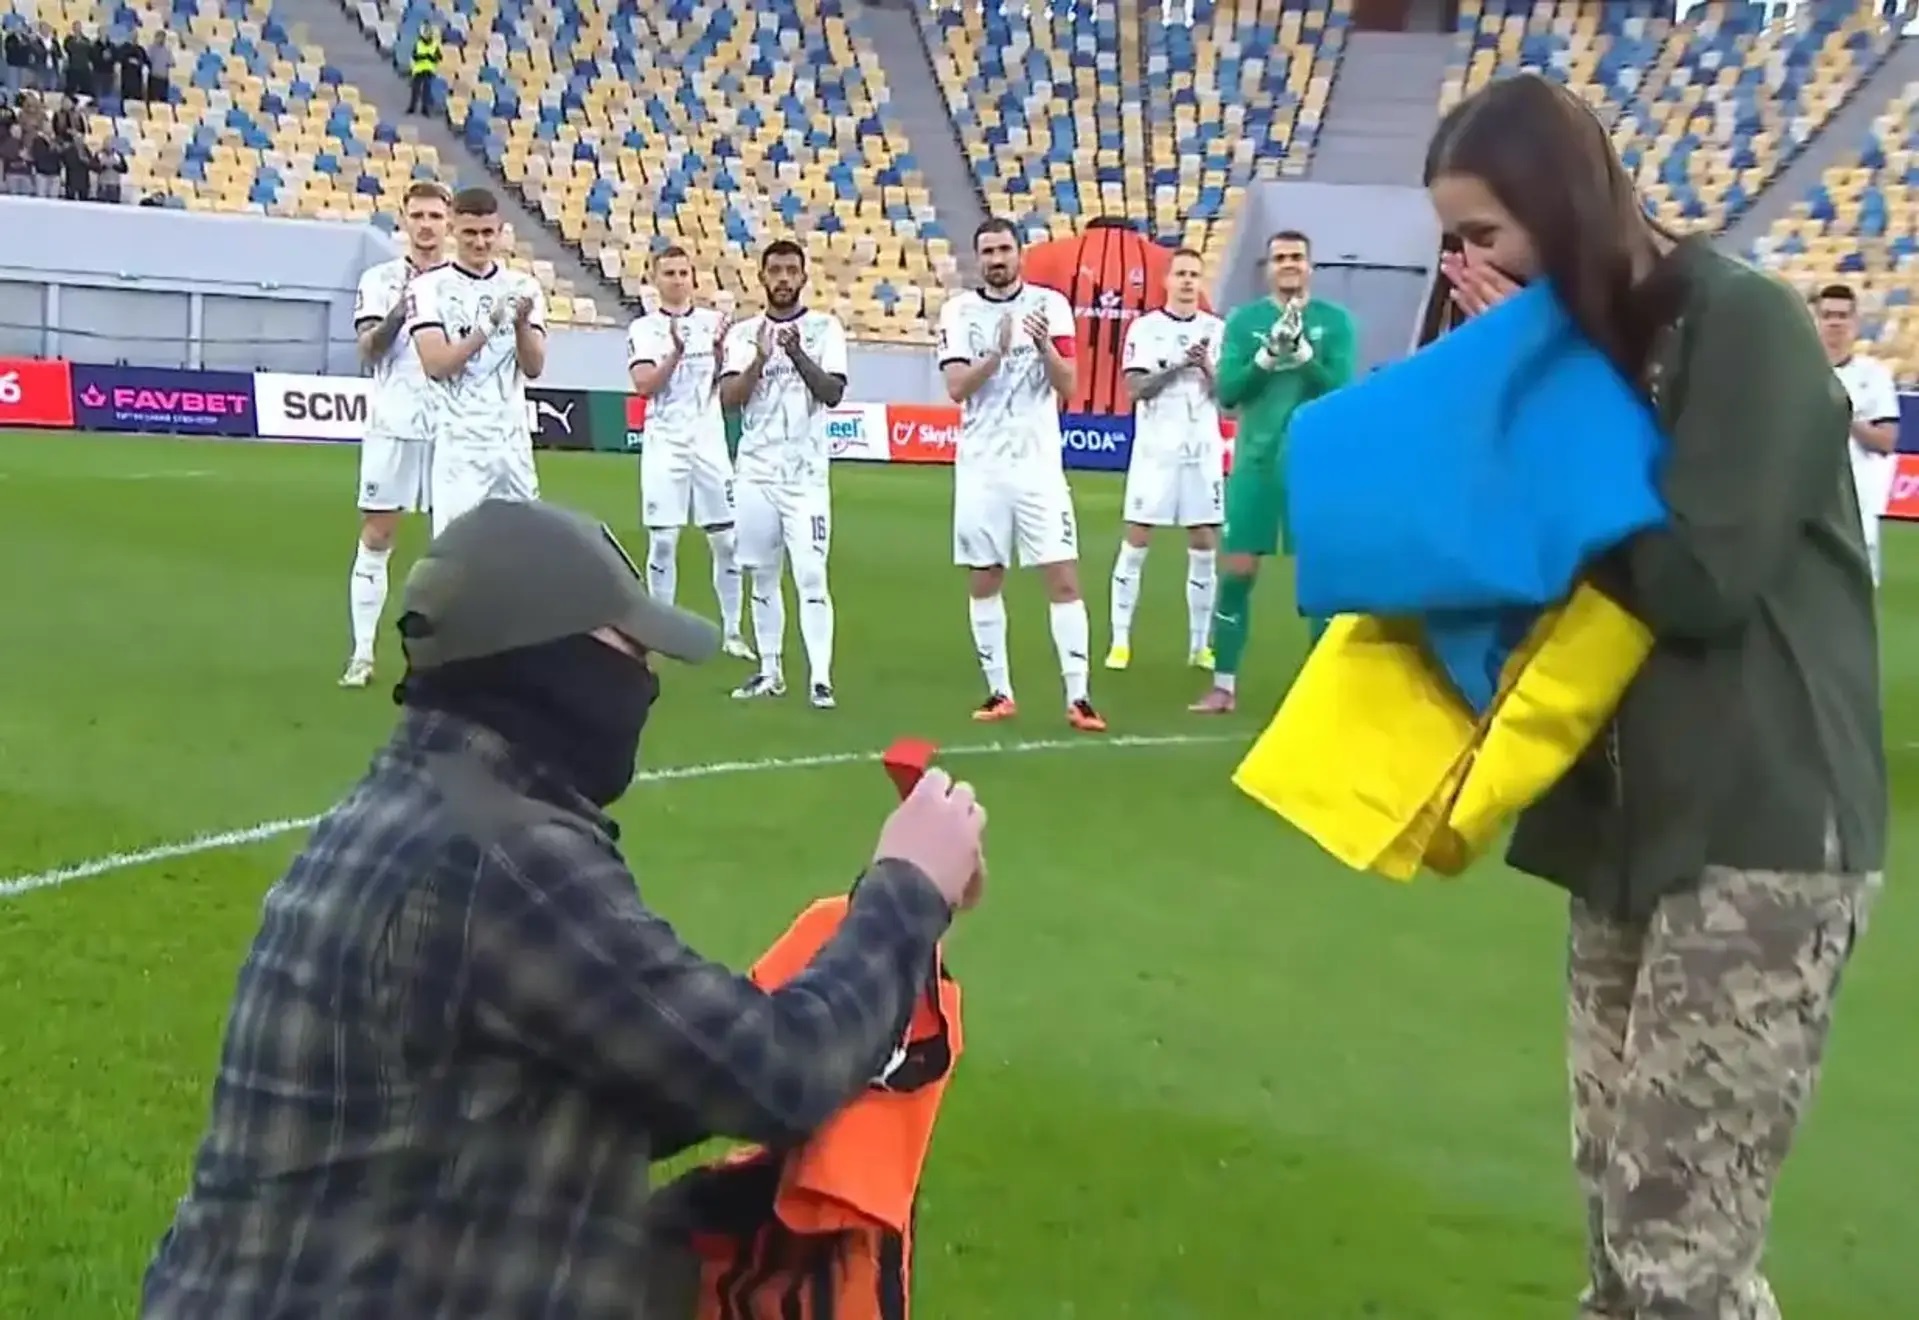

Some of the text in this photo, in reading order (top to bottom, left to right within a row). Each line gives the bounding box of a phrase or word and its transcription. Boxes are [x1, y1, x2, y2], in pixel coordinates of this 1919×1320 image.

[113, 388, 248, 413] FAVBET
[283, 390, 367, 423] SCM
[827, 417, 858, 438] eel
[811, 515, 826, 541] 16
